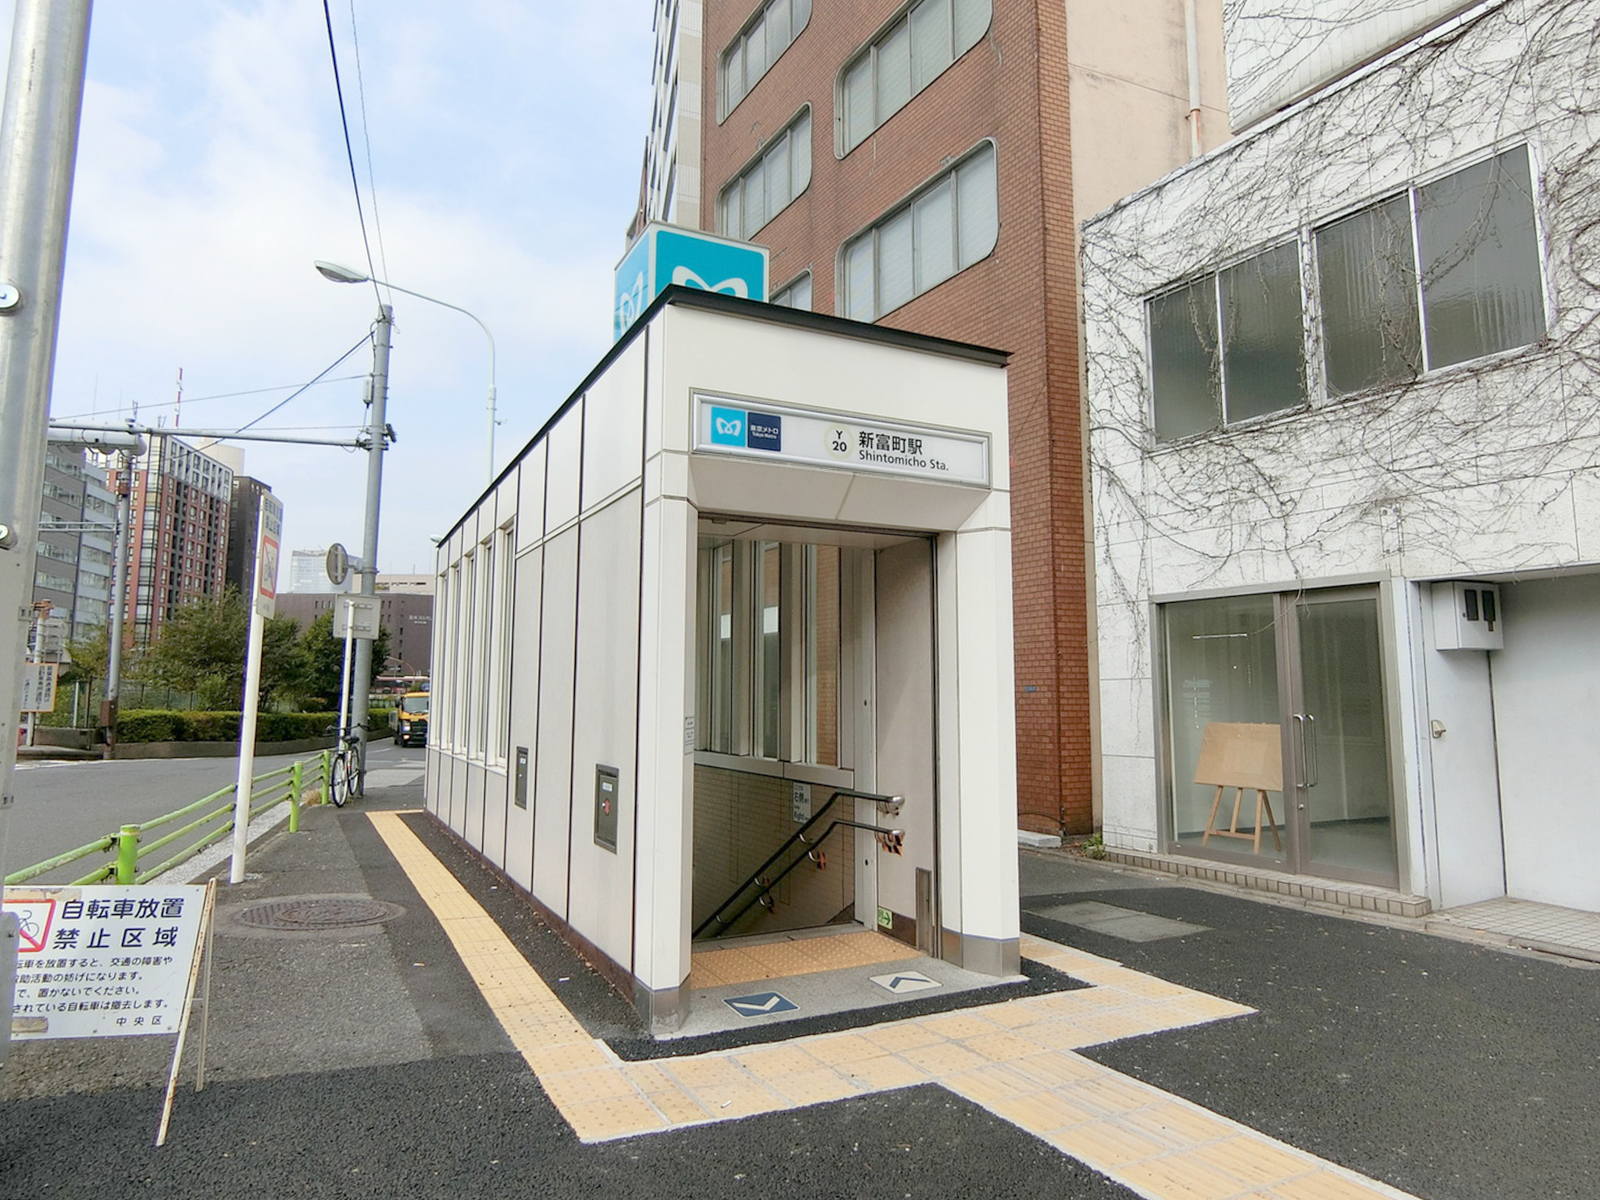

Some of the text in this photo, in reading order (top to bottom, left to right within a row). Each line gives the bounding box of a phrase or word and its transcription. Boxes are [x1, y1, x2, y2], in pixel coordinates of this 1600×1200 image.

[832, 440, 848, 452] 20
[836, 430, 843, 440] Y
[858, 430, 923, 455] 新富町駅
[858, 449, 949, 471] Shintomicho Sta.
[62, 898, 185, 920] 自転車放置
[52, 926, 179, 950] 禁止区域
[116, 1015, 163, 1027] 中央区
